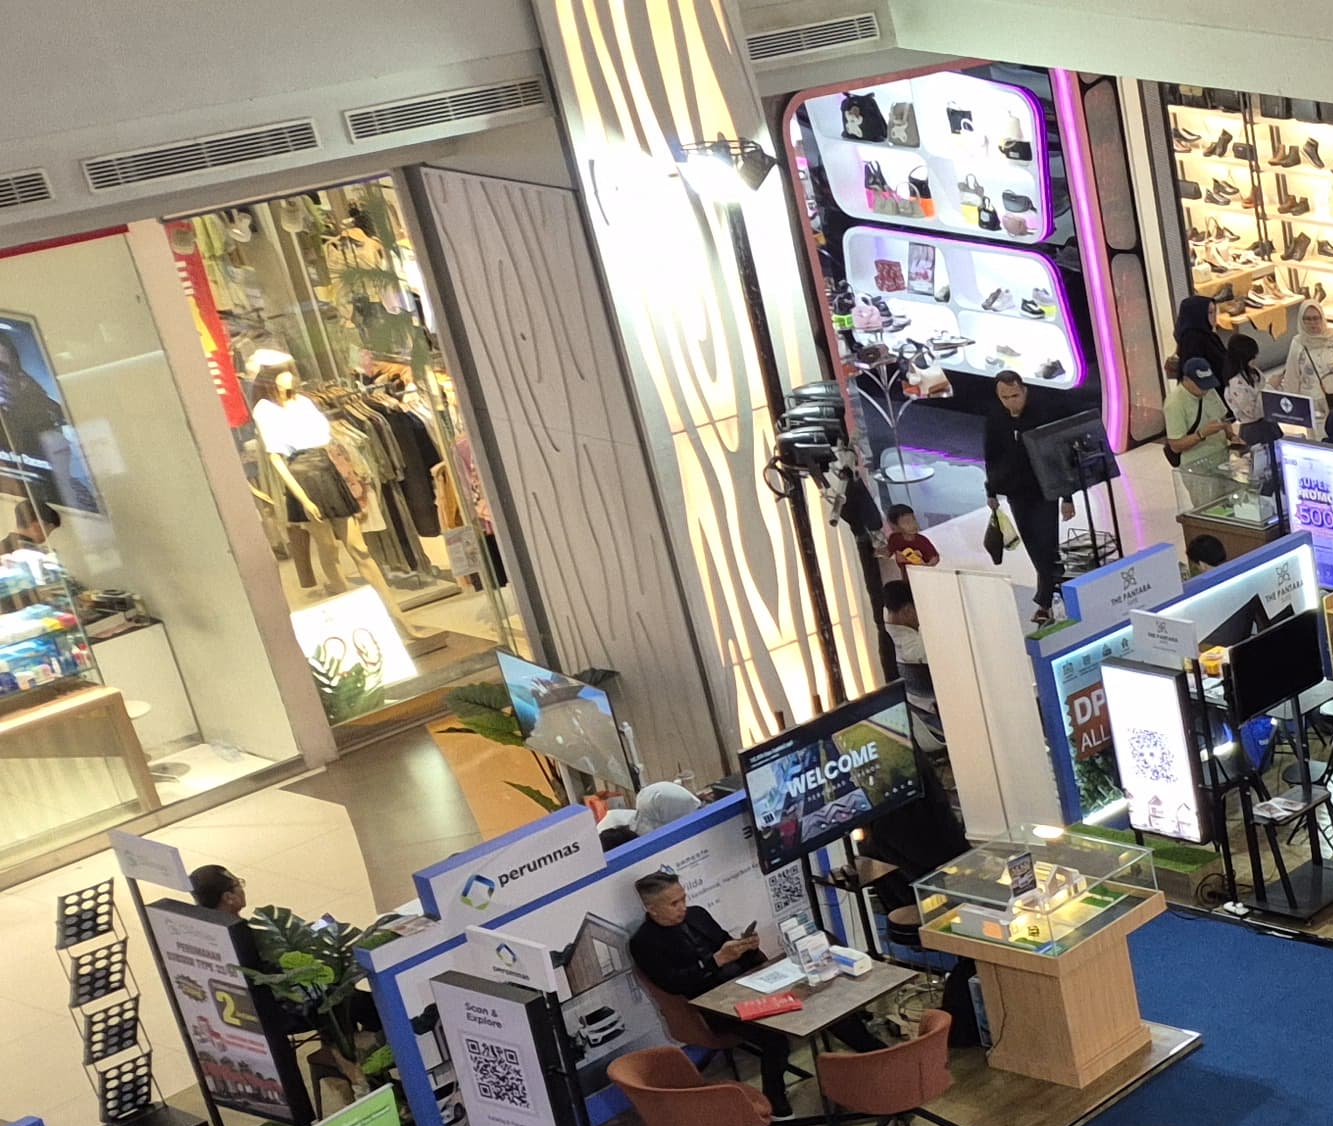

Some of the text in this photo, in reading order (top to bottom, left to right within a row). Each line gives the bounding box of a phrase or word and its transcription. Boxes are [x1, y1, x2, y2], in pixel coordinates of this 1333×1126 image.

[1123, 583, 1152, 602] PANTARA
[1277, 580, 1305, 600] PANTARA
[1073, 689, 1107, 726] DP
[1081, 725, 1111, 752] ALL
[786, 741, 880, 798] WELCOME
[498, 840, 581, 888] perumnas
[216, 990, 241, 1026] 2
[464, 1001, 490, 1017] Scan
[466, 1012, 503, 1030] Explore
